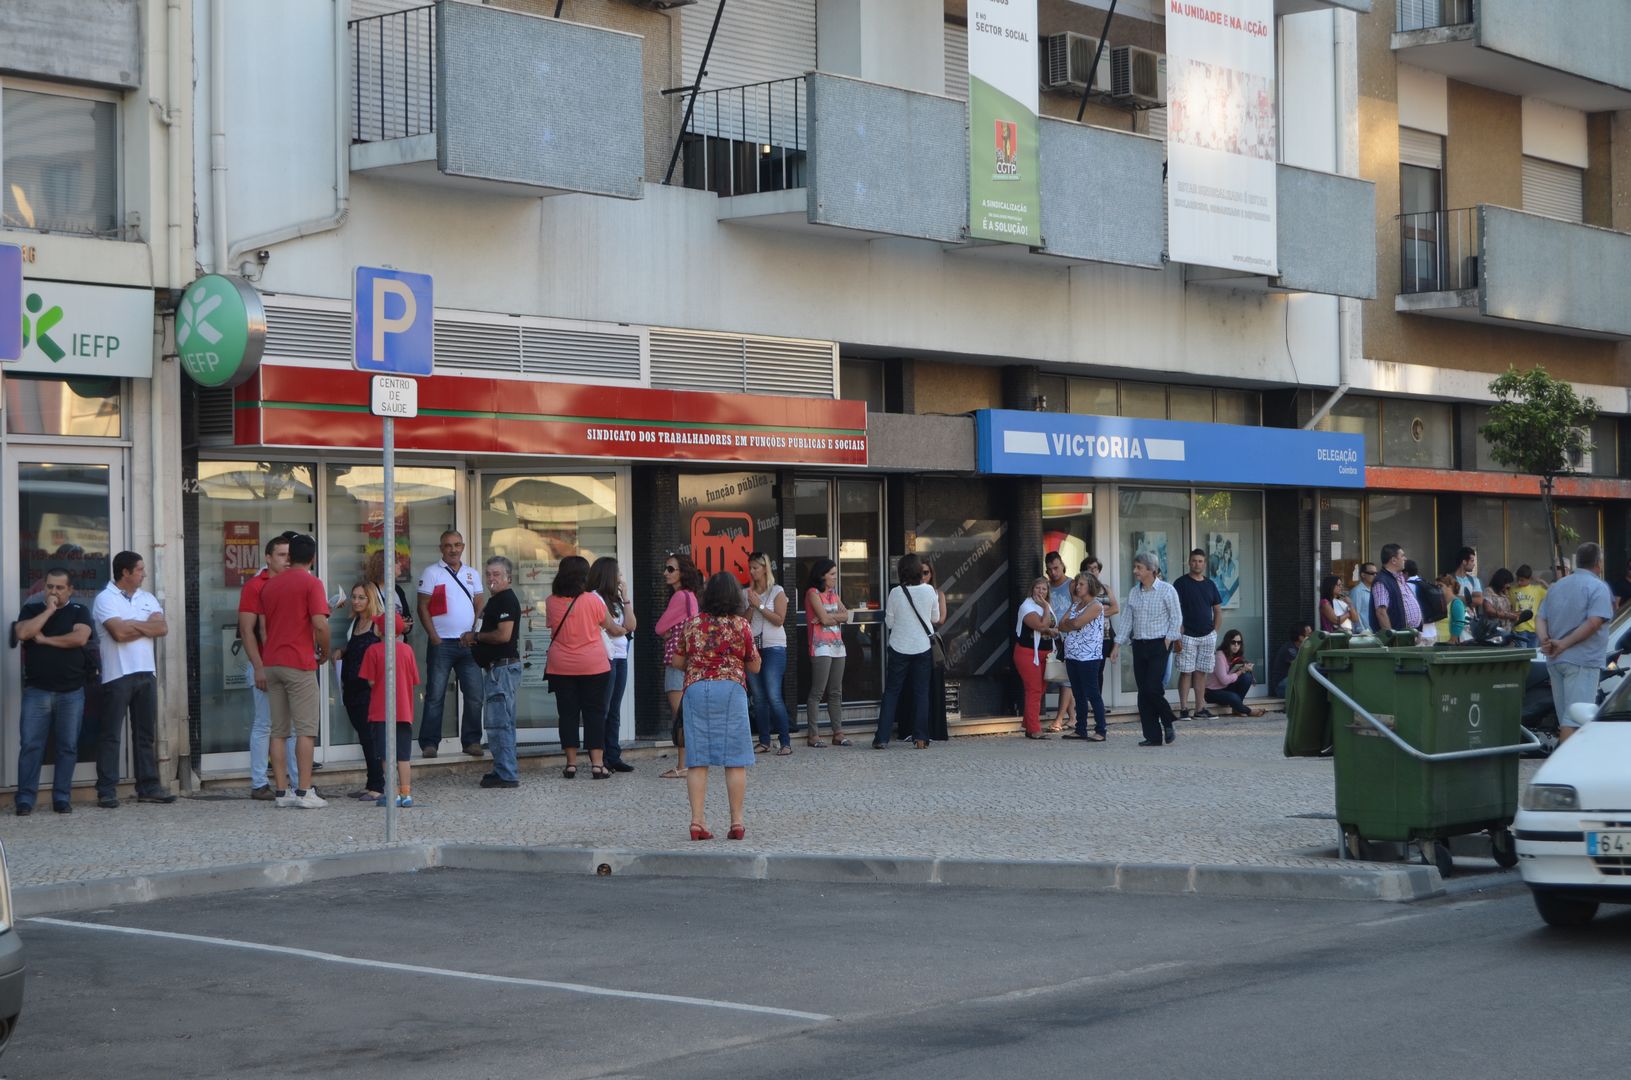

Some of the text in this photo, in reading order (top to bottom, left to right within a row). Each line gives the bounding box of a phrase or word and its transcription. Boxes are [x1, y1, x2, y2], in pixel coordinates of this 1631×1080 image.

[976, 21, 1029, 42] SECTOR SOCIAL
[1184, 4, 1222, 25] UNIDADE
[1223, 14, 1228, 26] E
[1230, 15, 1242, 31] NA
[1243, 18, 1268, 37] ACÇÃO
[996, 161, 1017, 175] CGTP
[982, 216, 988, 230] É
[989, 220, 994, 231] A
[994, 221, 1028, 236] SOLUÇÃO!
[372, 277, 417, 362] P
[72, 333, 120, 358] IEFP
[184, 351, 220, 373] IEFP
[379, 377, 410, 390] CENTRO
[388, 390, 401, 401] DE
[586, 428, 865, 451] SINDICATO DOS TRABALHADORES EM FUNÇÕES PÚBLICAS E SOCIAIS
[1051, 432, 1143, 459] VICTORIA
[1317, 448, 1357, 464] DELEGAÇÃO
[1338, 465, 1358, 475] Coimbra
[182, 478, 199, 493] 42
[705, 474, 769, 503] função pública
[226, 544, 259, 569] SIM
[954, 539, 993, 579] VICTORIA
